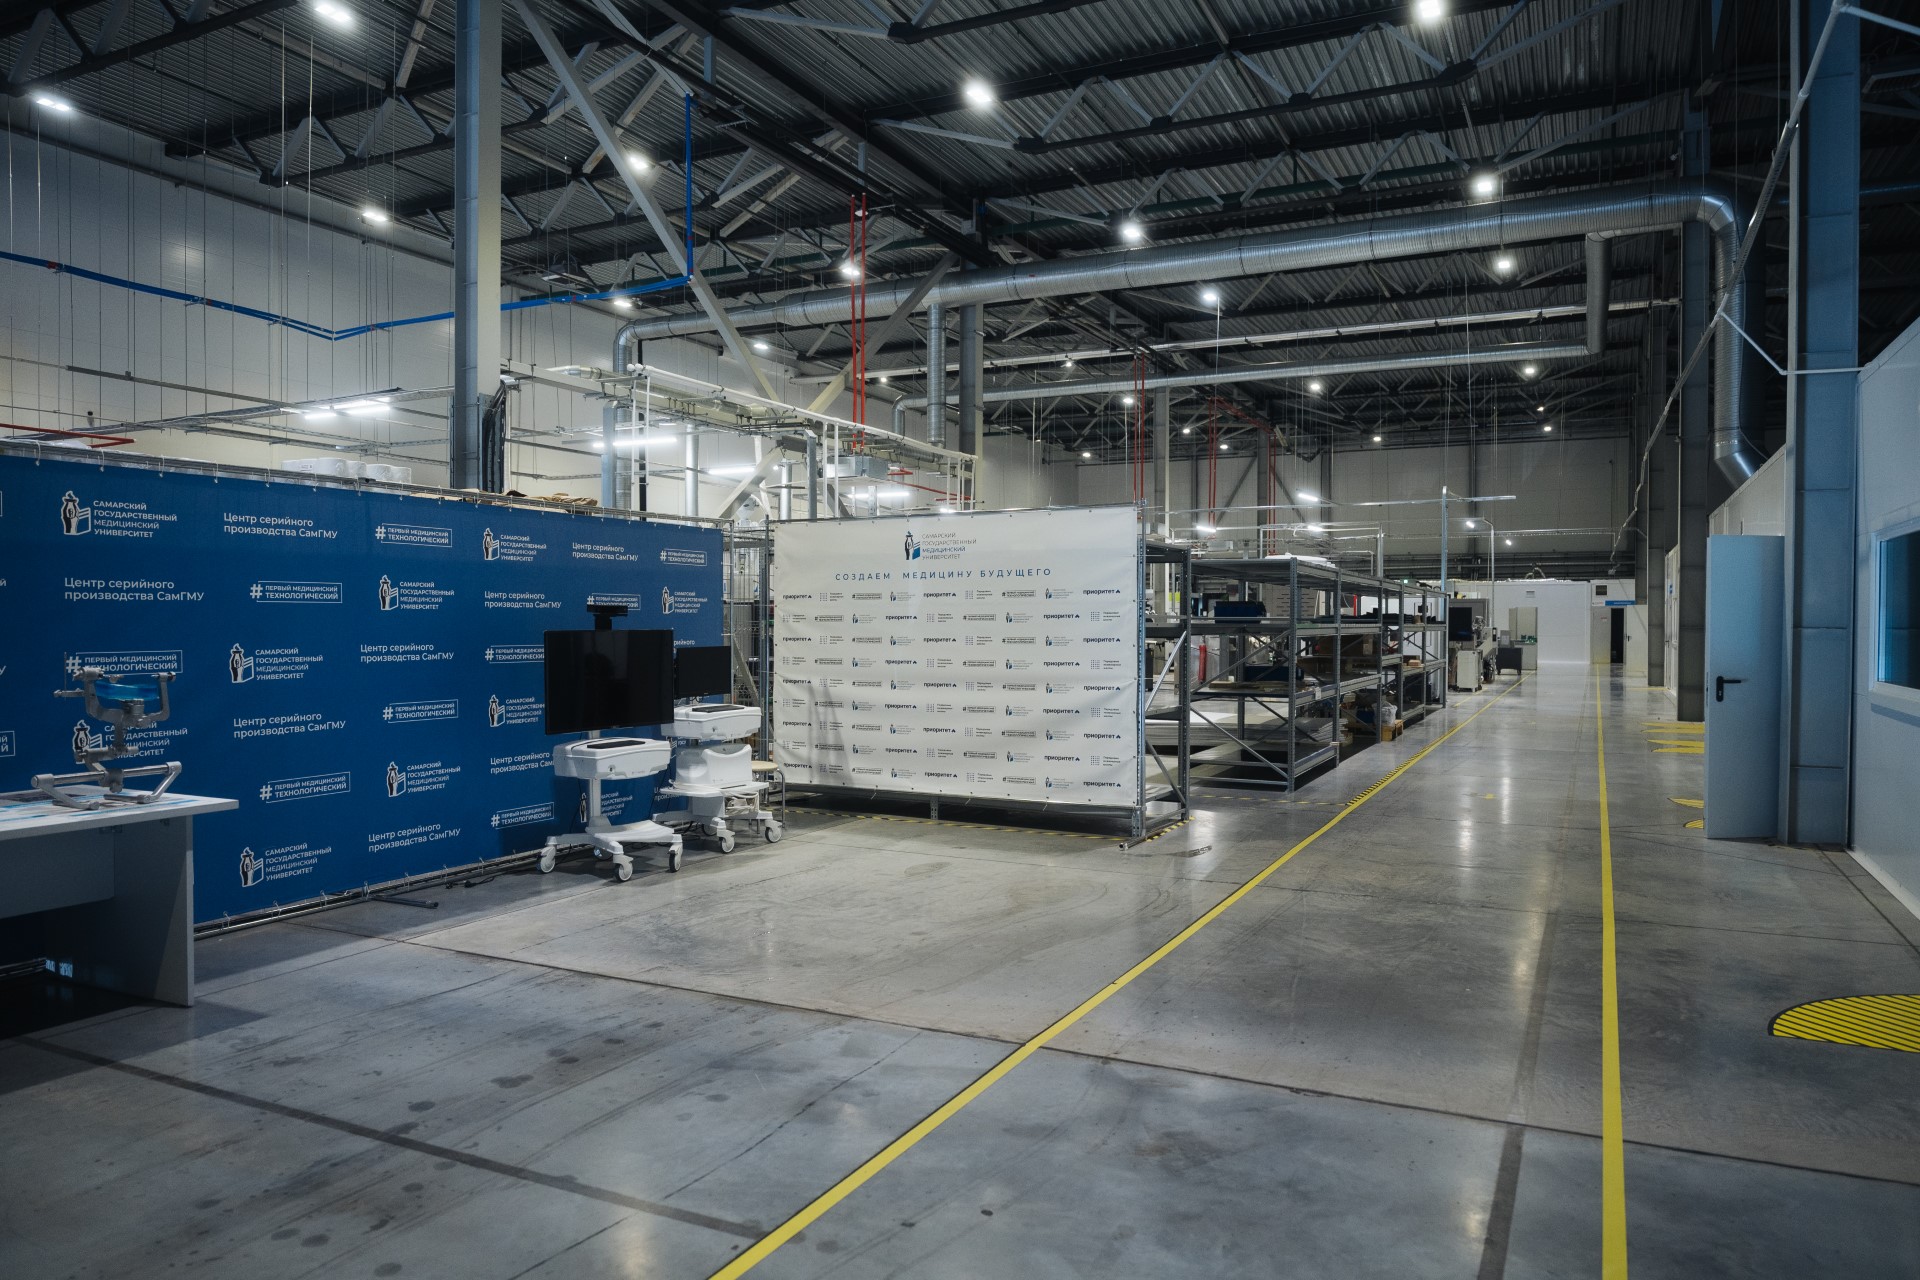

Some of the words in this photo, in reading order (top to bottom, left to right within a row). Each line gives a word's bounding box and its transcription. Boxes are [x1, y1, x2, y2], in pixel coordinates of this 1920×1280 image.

[94, 500, 146, 510] САМАРСКИЙ
[94, 510, 177, 522] ГОСУДАРСТВЕННЫЙ
[224, 512, 256, 524] Центр
[260, 516, 313, 526] серийного
[94, 519, 159, 529] МЕДИЦИНСКИЙ
[94, 528, 153, 538] УНИВЕРСИТЕТ
[224, 525, 296, 536] производства
[299, 528, 338, 539] СамГМУ
[388, 534, 448, 544] ТЕХНОЛОГИЧЕСКИЙ
[572, 542, 592, 551] Центр
[592, 544, 624, 552] серийного
[572, 552, 614, 560] производства
[616, 553, 638, 562] СамГМУ
[836, 573, 891, 581] СОЗДАЕМ
[903, 570, 972, 580] МЕДИЦИНУ
[980, 568, 1050, 578] БУДУЩЕГО
[64, 578, 105, 589] Центр
[108, 579, 174, 590] серийного
[65, 592, 154, 602] производства
[156, 591, 204, 601] СамГМУ
[485, 591, 506, 600] Центр
[508, 592, 544, 600] серийного
[485, 600, 534, 609] производства
[535, 601, 562, 609] СамГМУ
[360, 644, 388, 654] Центр
[390, 643, 434, 652] серийного
[673, 638, 696, 647] рийного
[85, 656, 118, 664] ПЕРВЫЙ
[120, 654, 177, 662] МЕДИЦИНСКИЙ
[256, 655, 323, 664] ГОСУДАРСТВЕННЫЙ
[361, 654, 420, 663] производства
[422, 652, 454, 661] СамГМУ
[256, 664, 308, 672] МЕДИЦИНСКИЙ
[396, 708, 455, 720] ТЕХНОЛОГИЧЕСКИЙ
[234, 718, 266, 728] Центр
[268, 713, 322, 724] серийного
[234, 726, 305, 740] производства
[308, 720, 346, 732] СамГМУ
[490, 756, 512, 766] Центр
[514, 752, 550, 763] серийного
[407, 761, 442, 771] САМАРСКИЙ
[408, 766, 460, 778] ГОСУДАРСТВЕННЫЙ
[490, 762, 538, 775] производства
[540, 760, 554, 768] Сам
[274, 782, 300, 790] ПЕРВЫЙ
[302, 776, 346, 787] МЕДИЦИНСКИЙ
[408, 775, 450, 786] МЕДИЦИНСКИЙ
[275, 782, 346, 798] ТЕХНОЛОГИЧЕСКИЙ
[408, 783, 446, 793] УНИВЕРСИТЕТ
[368, 832, 396, 842] Центр
[398, 823, 440, 836] серийного
[368, 836, 427, 852] производства
[429, 828, 460, 841] СамГМУ
[265, 843, 308, 856] САМАРСКИЙ
[266, 847, 332, 864] ГОСУДАРСТВЕННЫЙ
[266, 858, 318, 872] МЕДИЦИНСКИЙ
[266, 867, 313, 882] УНИВЕРСИТЕТ
